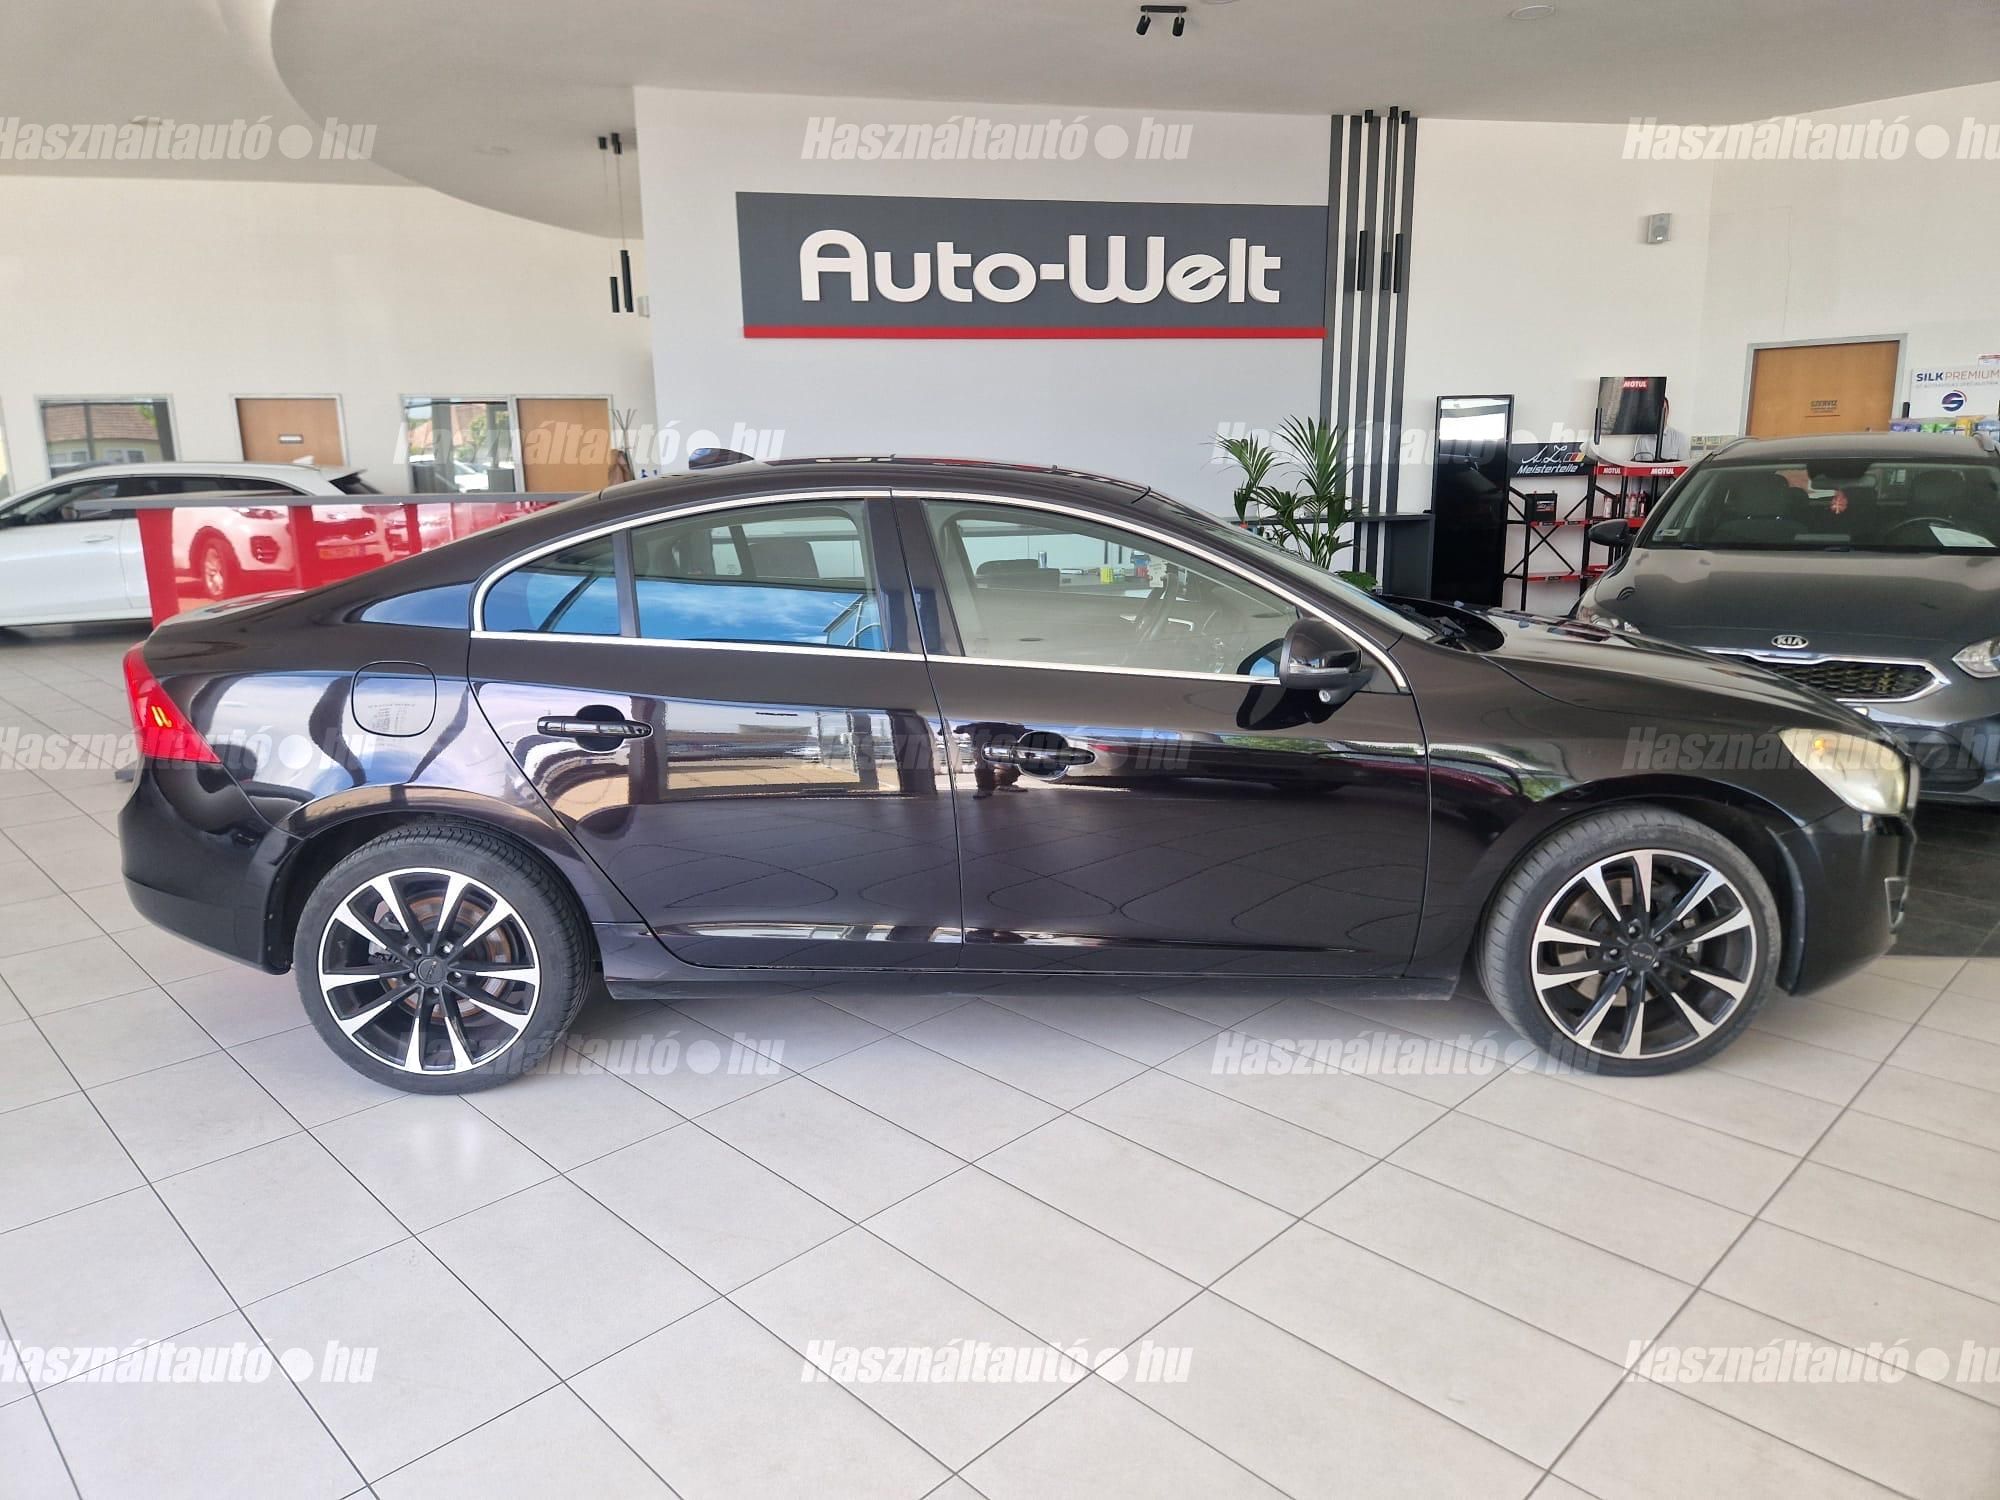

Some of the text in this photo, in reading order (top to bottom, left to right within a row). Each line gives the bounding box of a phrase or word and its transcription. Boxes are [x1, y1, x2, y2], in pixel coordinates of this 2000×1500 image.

[799, 229, 1281, 303] Auto-Welt
[1623, 380, 1647, 388] MOTUL
[1516, 463, 1579, 474] Meisterteile
[1776, 636, 1803, 645] KIA
